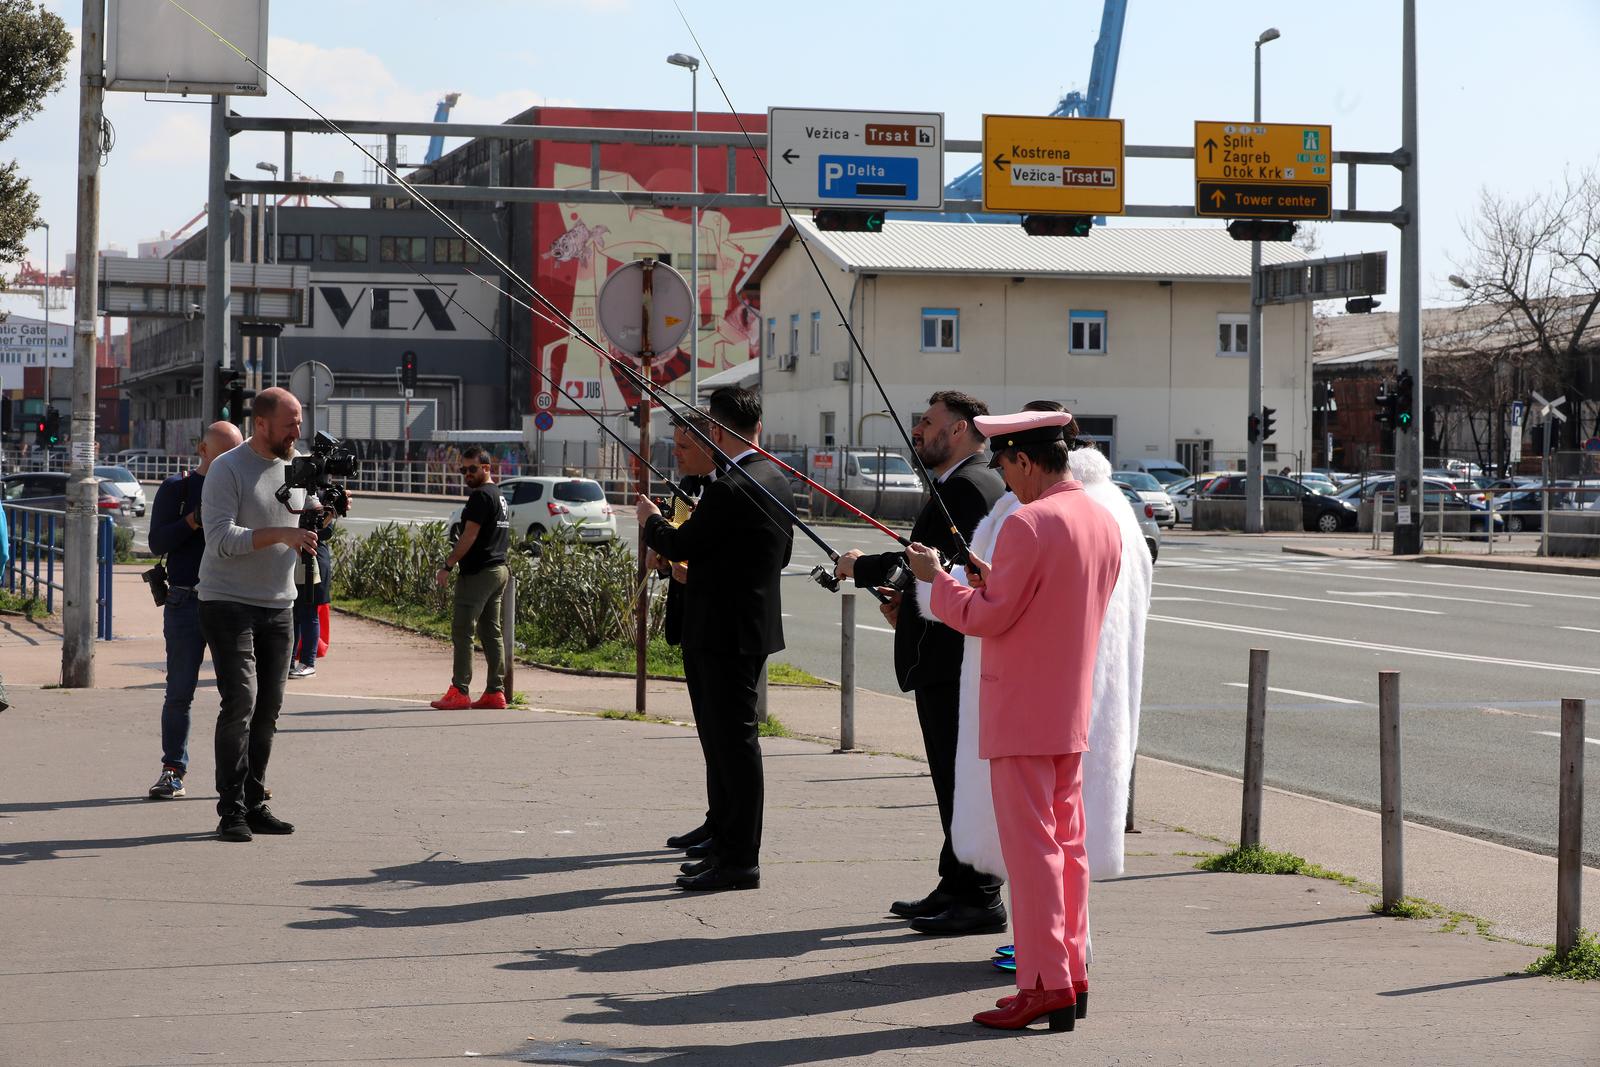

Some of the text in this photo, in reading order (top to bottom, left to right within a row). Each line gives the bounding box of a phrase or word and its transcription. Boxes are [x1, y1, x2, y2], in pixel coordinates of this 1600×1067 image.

[805, 127, 849, 140] Vežica
[869, 128, 909, 142] Trsat
[1223, 134, 1255, 150] Split
[1012, 145, 1070, 160] Kostrena
[1223, 150, 1271, 166] Zagreb
[825, 162, 885, 191] P Delta
[1064, 169, 1098, 184] Trsat
[1223, 165, 1282, 179] Otok Krk
[1235, 193, 1317, 207] Tower center
[21, 325, 47, 335] Gate
[584, 381, 601, 399] JUB
[538, 395, 550, 407] 60
[1514, 406, 1521, 422] P
